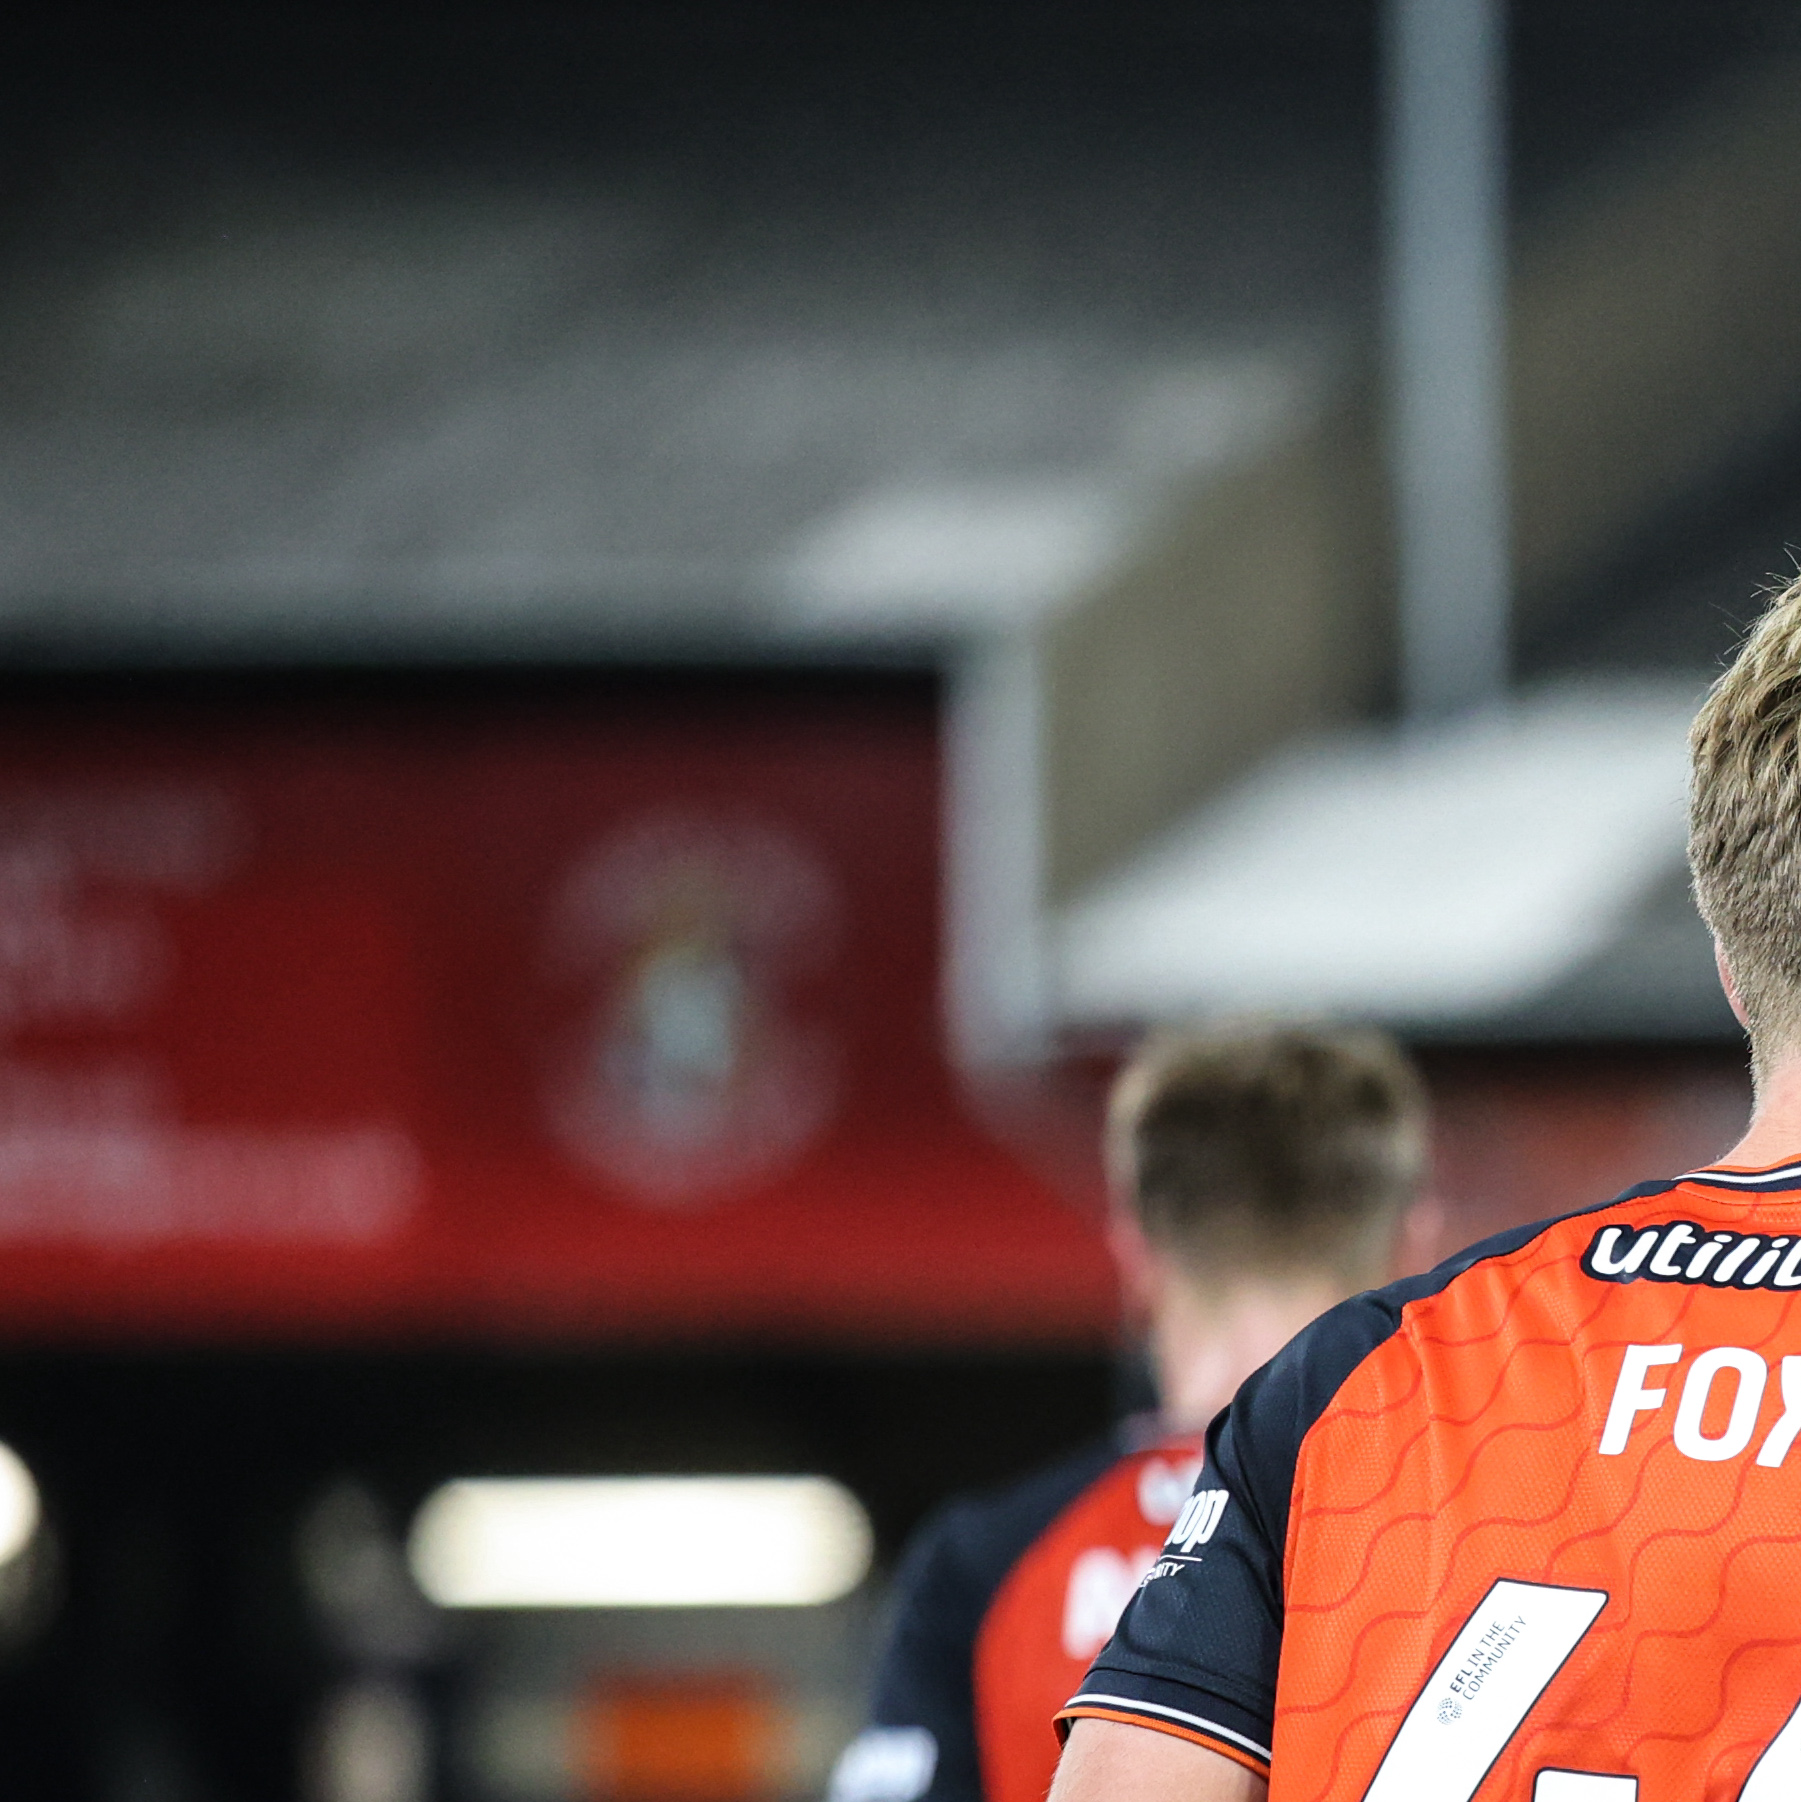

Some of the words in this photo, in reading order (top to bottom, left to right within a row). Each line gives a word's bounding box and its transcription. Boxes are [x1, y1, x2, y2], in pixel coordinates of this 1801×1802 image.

[1449, 1668, 1473, 1693] EFL
[1466, 1648, 1485, 1667] IN
[1480, 1620, 1505, 1647] THE
[1462, 1615, 1527, 1700] COMMUNITY
